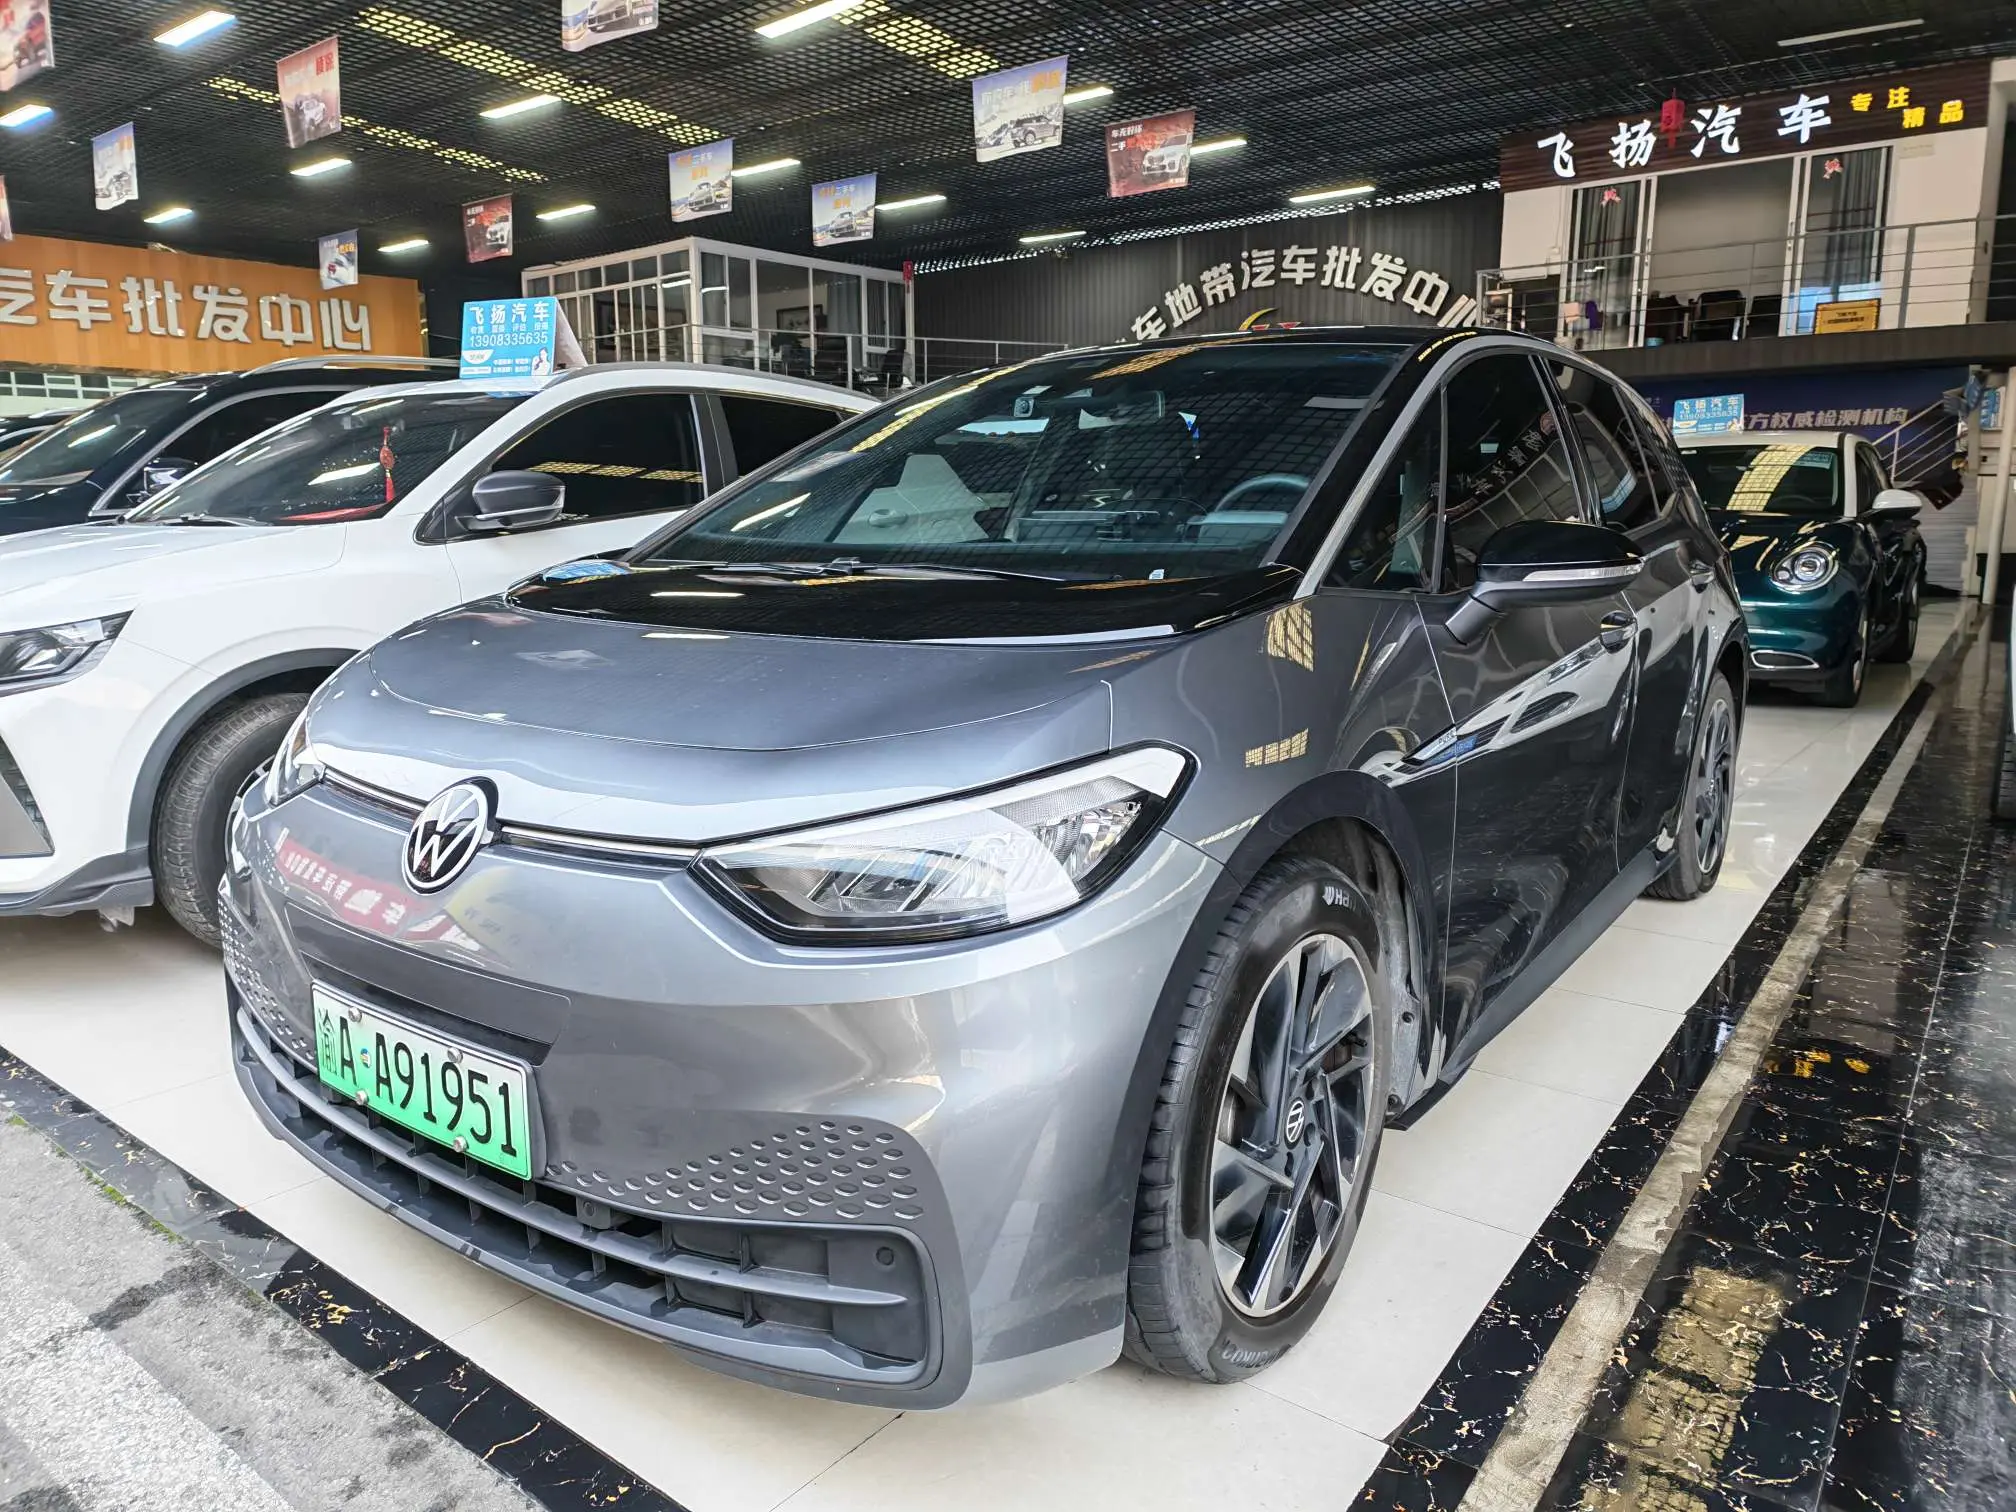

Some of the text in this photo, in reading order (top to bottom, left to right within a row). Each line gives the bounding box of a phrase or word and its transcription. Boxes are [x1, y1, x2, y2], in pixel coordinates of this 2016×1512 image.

[1851, 86, 1910, 112] 专注
[1902, 99, 1964, 129] 精品
[1537, 93, 1832, 178] 飞扬汽车
[1115, 244, 1477, 343] 车地带汽车批发中心
[469, 301, 549, 325] 飞扬汽车
[470, 331, 548, 348] 13908335635
[1742, 407, 1909, 430] 方权威检测机构
